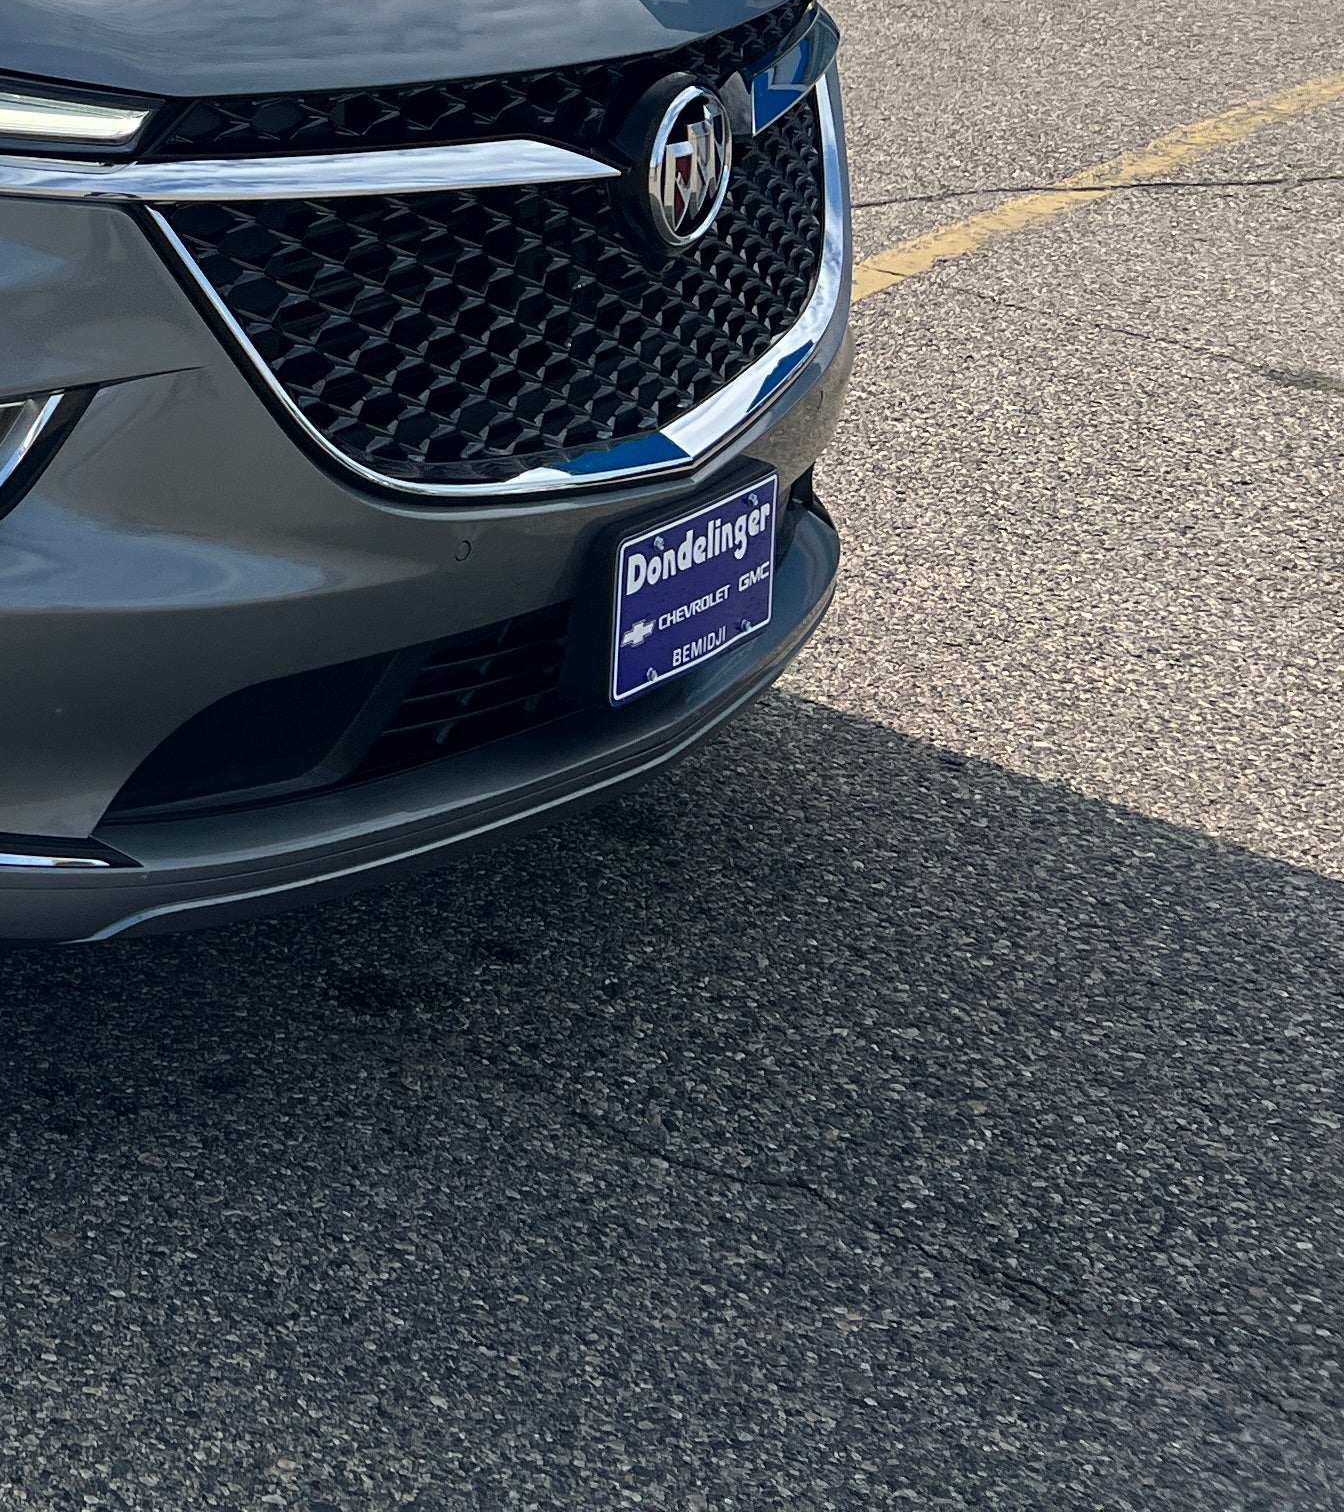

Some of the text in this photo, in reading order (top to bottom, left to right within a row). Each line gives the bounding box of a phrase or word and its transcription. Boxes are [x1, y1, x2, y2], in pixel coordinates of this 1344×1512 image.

[625, 502, 771, 596] Dondelinger
[658, 560, 771, 630] CHEVROLET GMC
[672, 625, 727, 667] BEMIDJI
